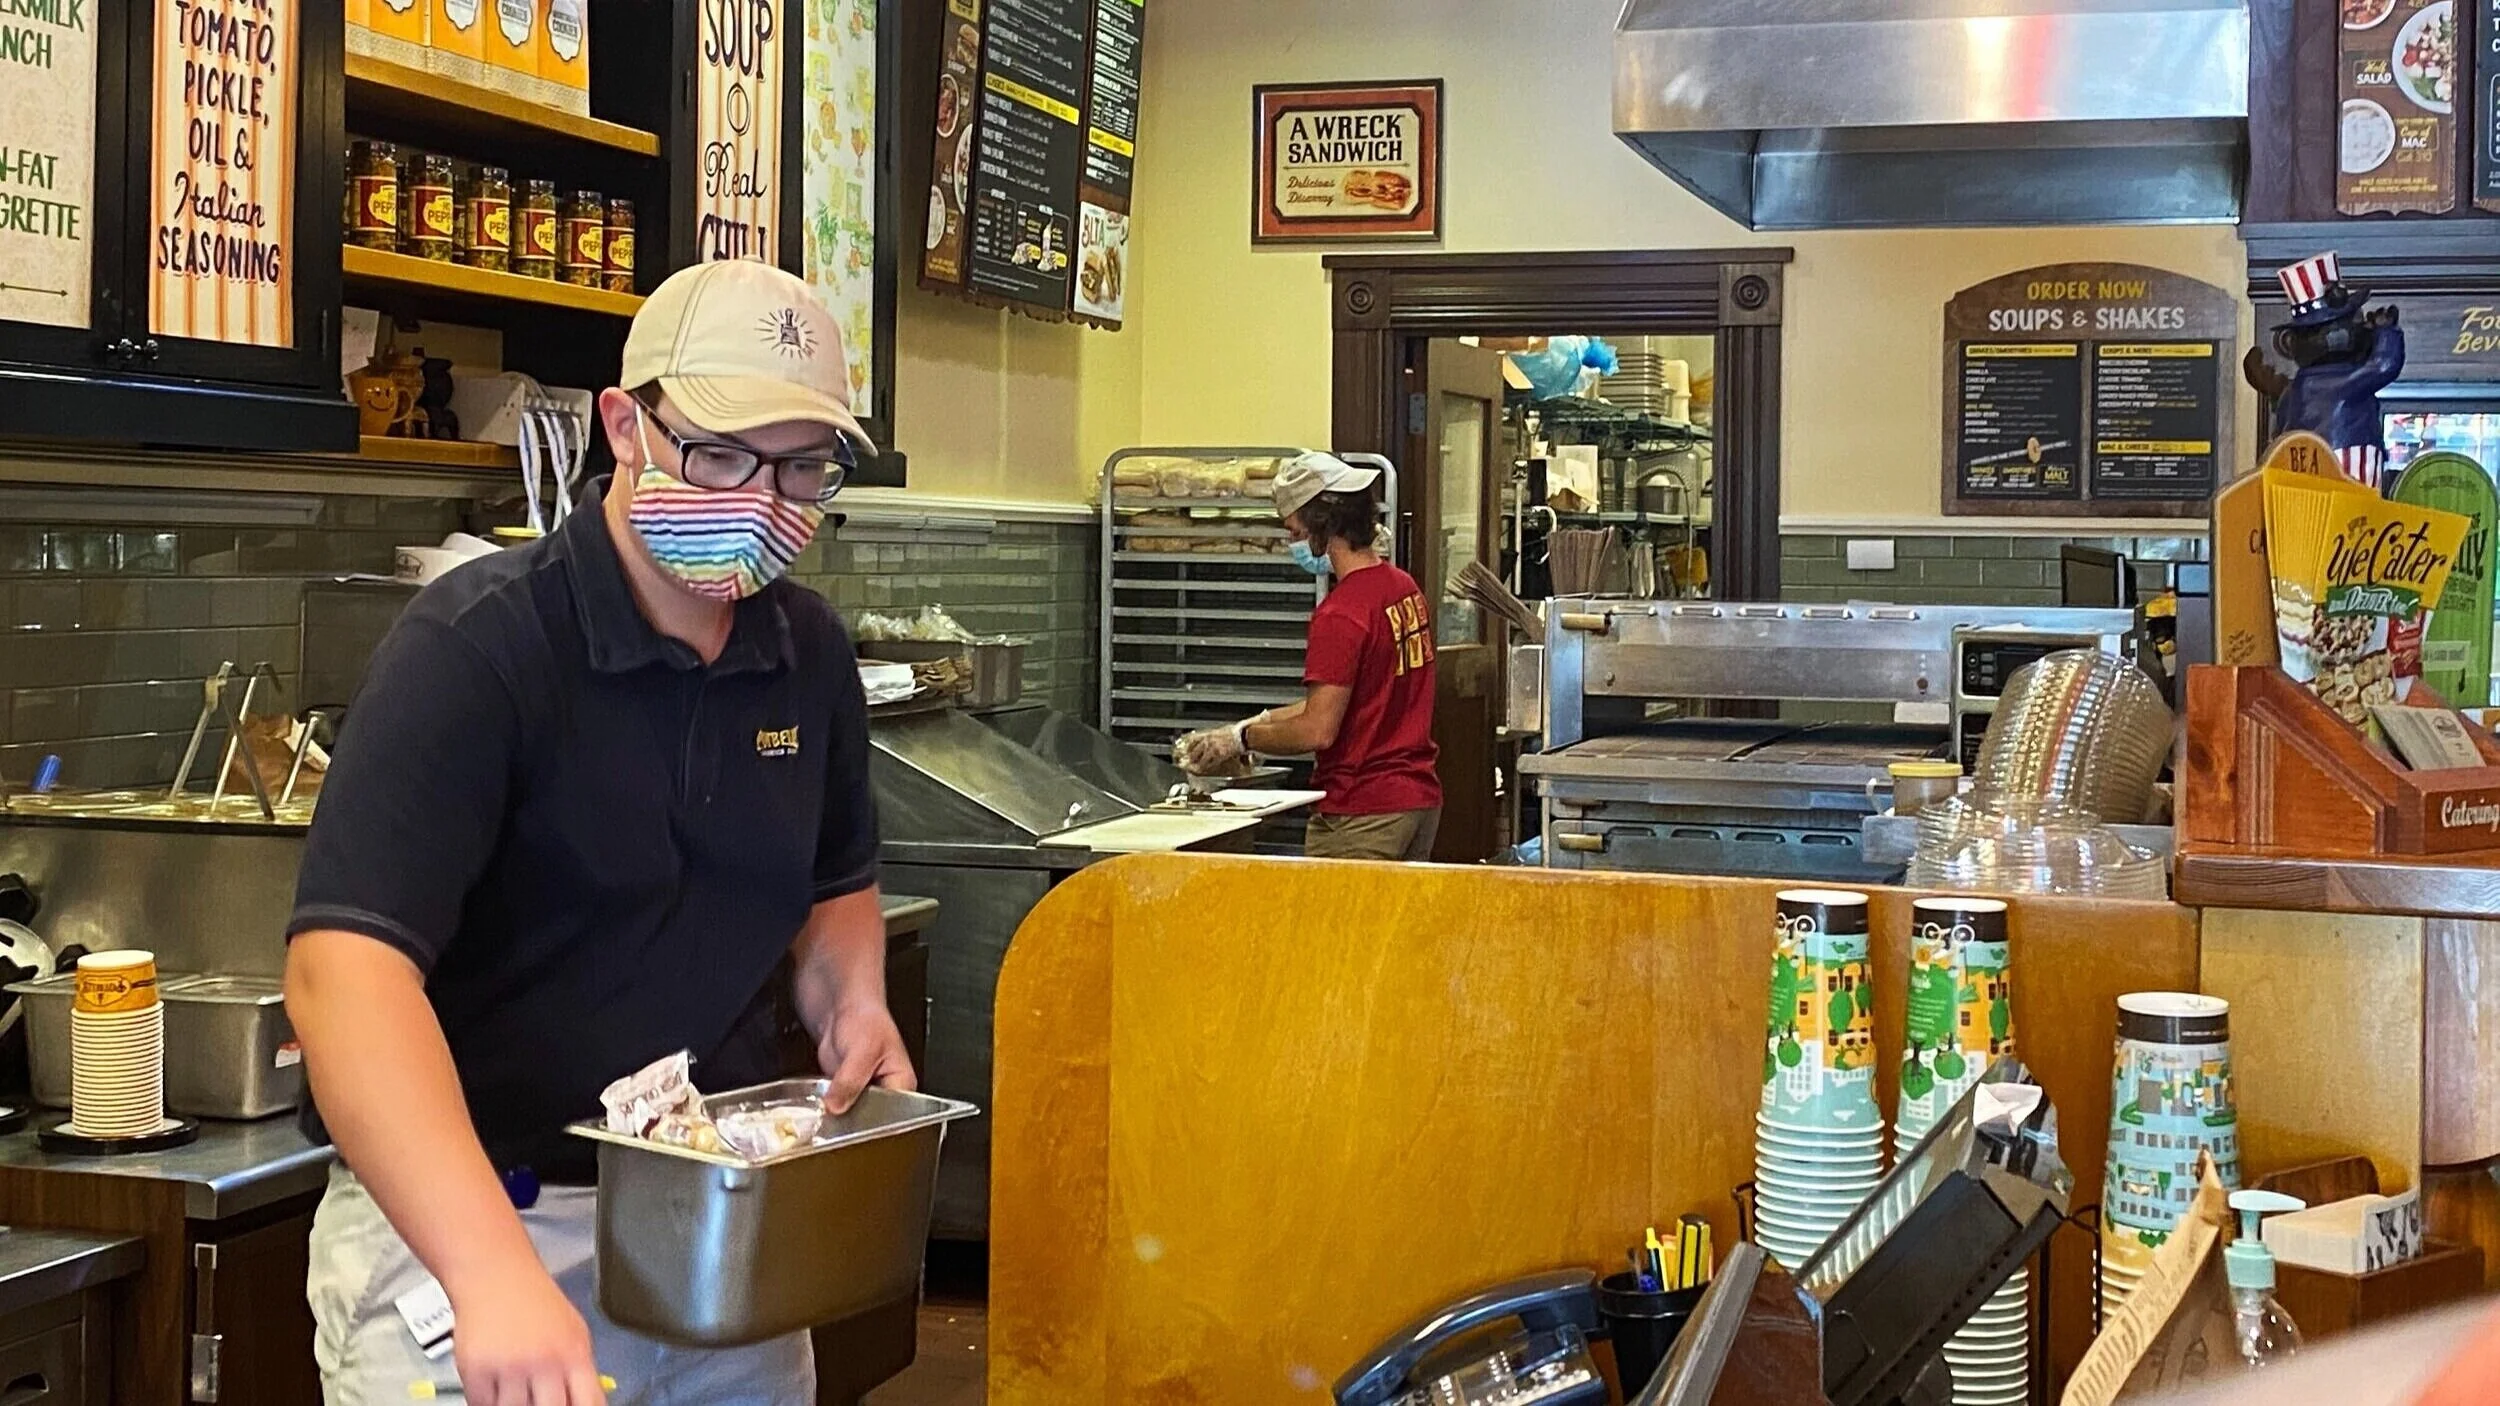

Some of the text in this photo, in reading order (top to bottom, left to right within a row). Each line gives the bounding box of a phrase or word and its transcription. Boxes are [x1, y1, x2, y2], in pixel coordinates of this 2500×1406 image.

[175, 0, 276, 76] TOMATO,
[705, 0, 774, 80] SOUP
[184, 60, 269, 129] PICKLE,
[2356, 72, 2392, 85] SALAD
[188, 117, 254, 170] OIL &
[1290, 115, 1402, 140] A WRECK
[2401, 137, 2427, 149] MAC
[1288, 140, 1402, 164] SANDWICH
[704, 141, 768, 198] Real
[173, 171, 266, 229] Italian
[157, 225, 281, 283] SEASONING
[2026, 280, 2146, 301] ORDER NOW
[1988, 307, 2186, 332] SOUPS & SHAKES
[2460, 306, 2500, 331] Fo
[2452, 331, 2500, 355] Bev
[2290, 447, 2319, 475] BE A
[2367, 520, 2450, 587] Cater
[2441, 796, 2500, 833] Catering
